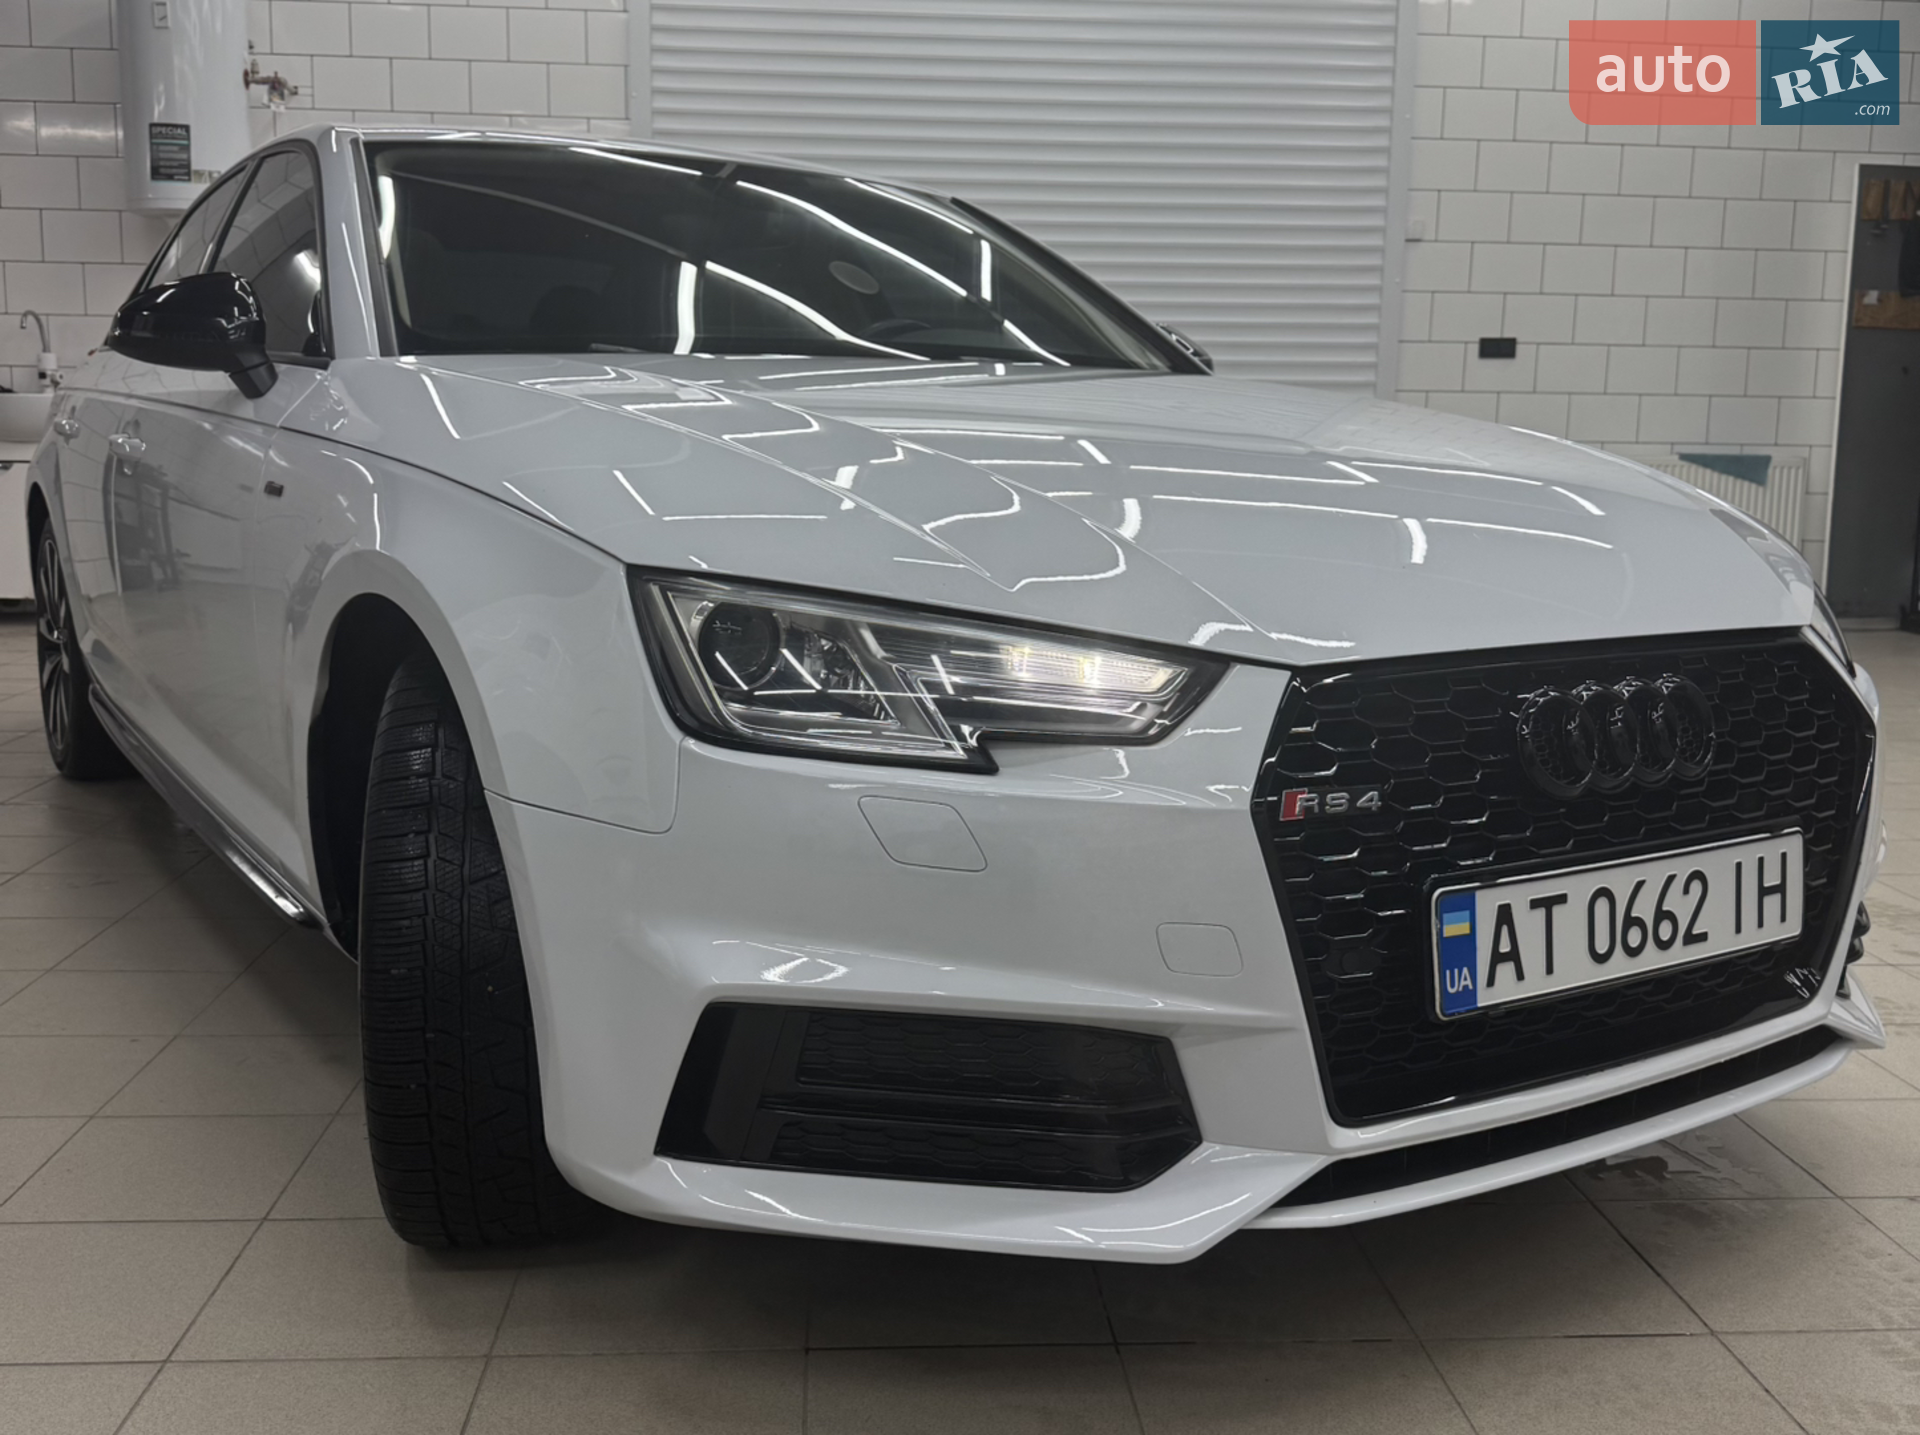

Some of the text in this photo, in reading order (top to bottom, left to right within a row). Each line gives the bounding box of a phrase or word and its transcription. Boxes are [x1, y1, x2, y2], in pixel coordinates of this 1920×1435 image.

[151, 126, 187, 134] SPECIAL
[1486, 850, 1788, 988] AT 0662 IH
[1446, 967, 1473, 994] UA
